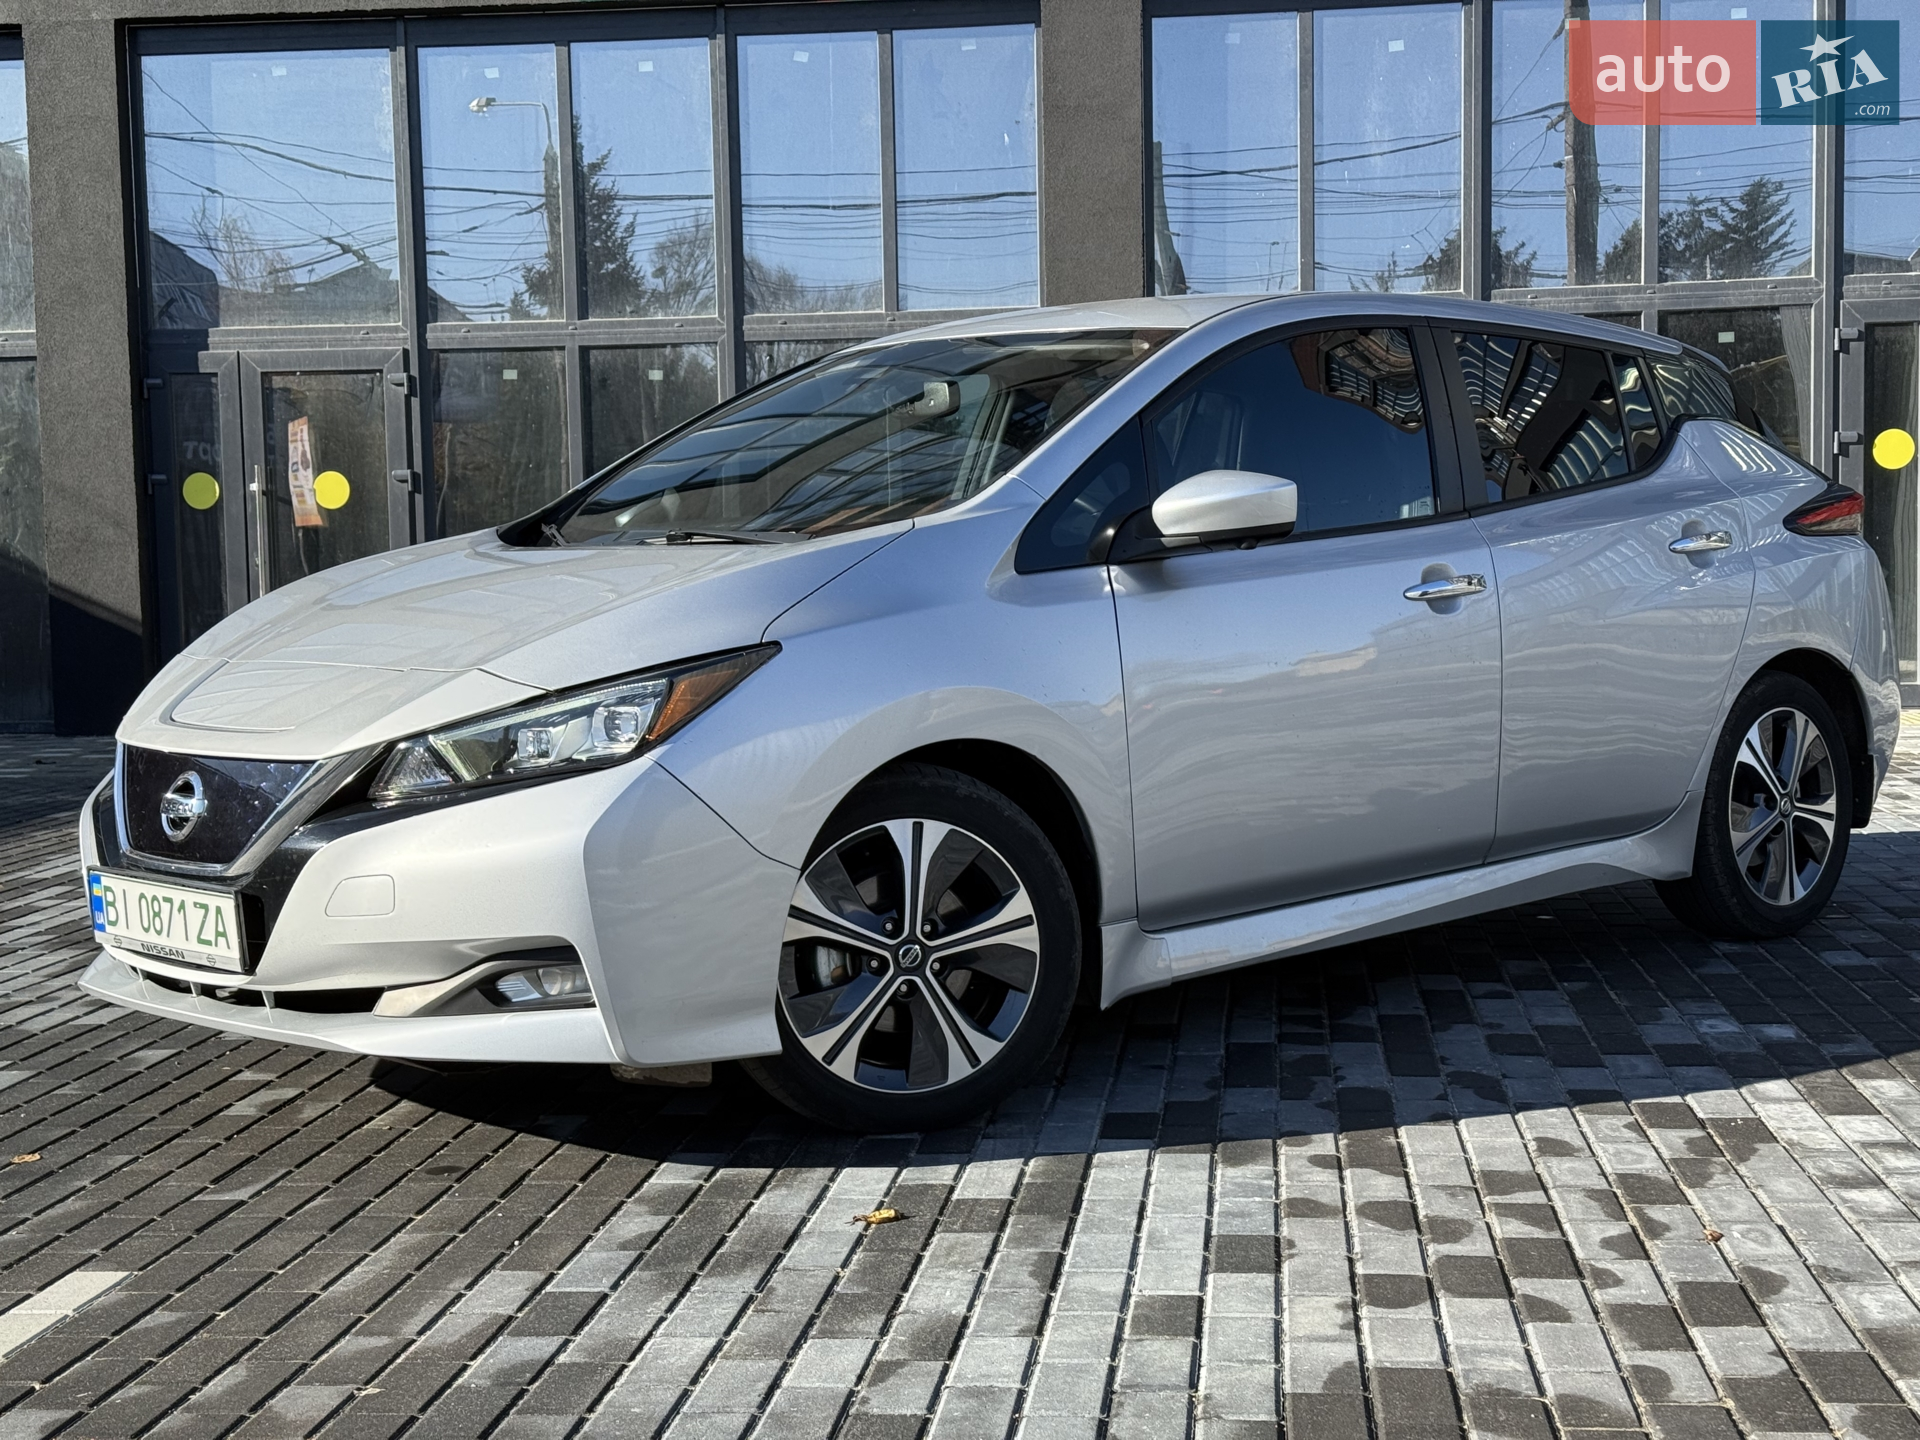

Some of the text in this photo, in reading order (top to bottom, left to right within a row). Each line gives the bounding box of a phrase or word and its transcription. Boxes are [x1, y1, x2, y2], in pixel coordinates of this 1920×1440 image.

[103, 885, 129, 930] BI
[95, 911, 105, 925] UA
[140, 943, 186, 960] NISSAN
